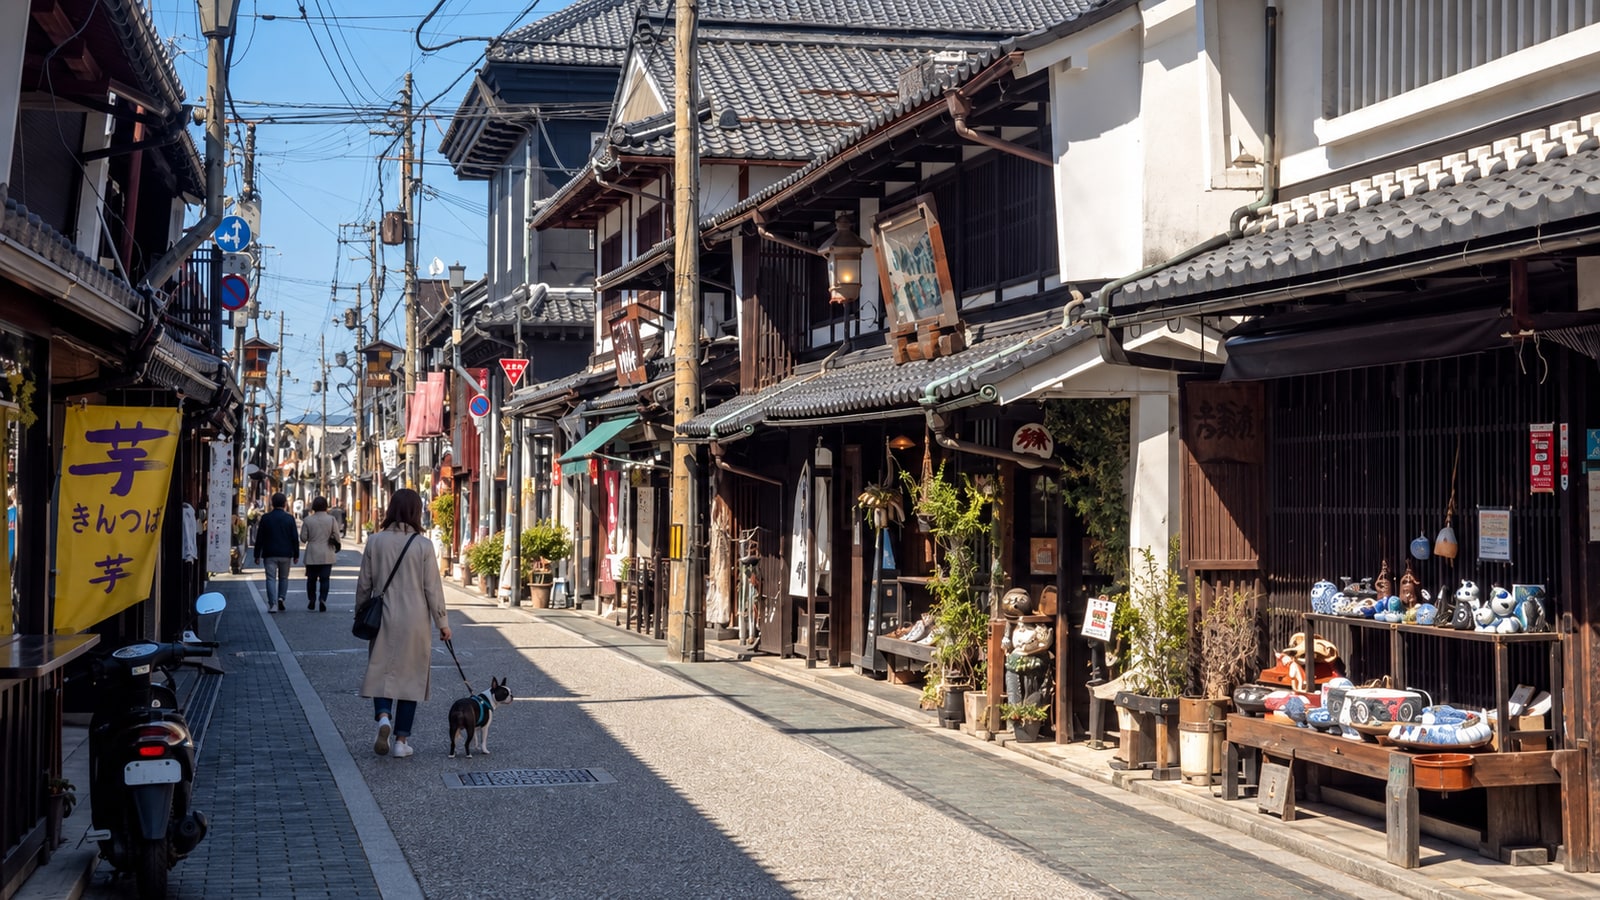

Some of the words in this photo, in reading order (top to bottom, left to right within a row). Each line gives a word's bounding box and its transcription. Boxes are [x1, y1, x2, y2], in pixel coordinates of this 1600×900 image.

[69, 421, 170, 496] 芋
[71, 503, 163, 534] きんつば
[90, 554, 134, 594] 芋
